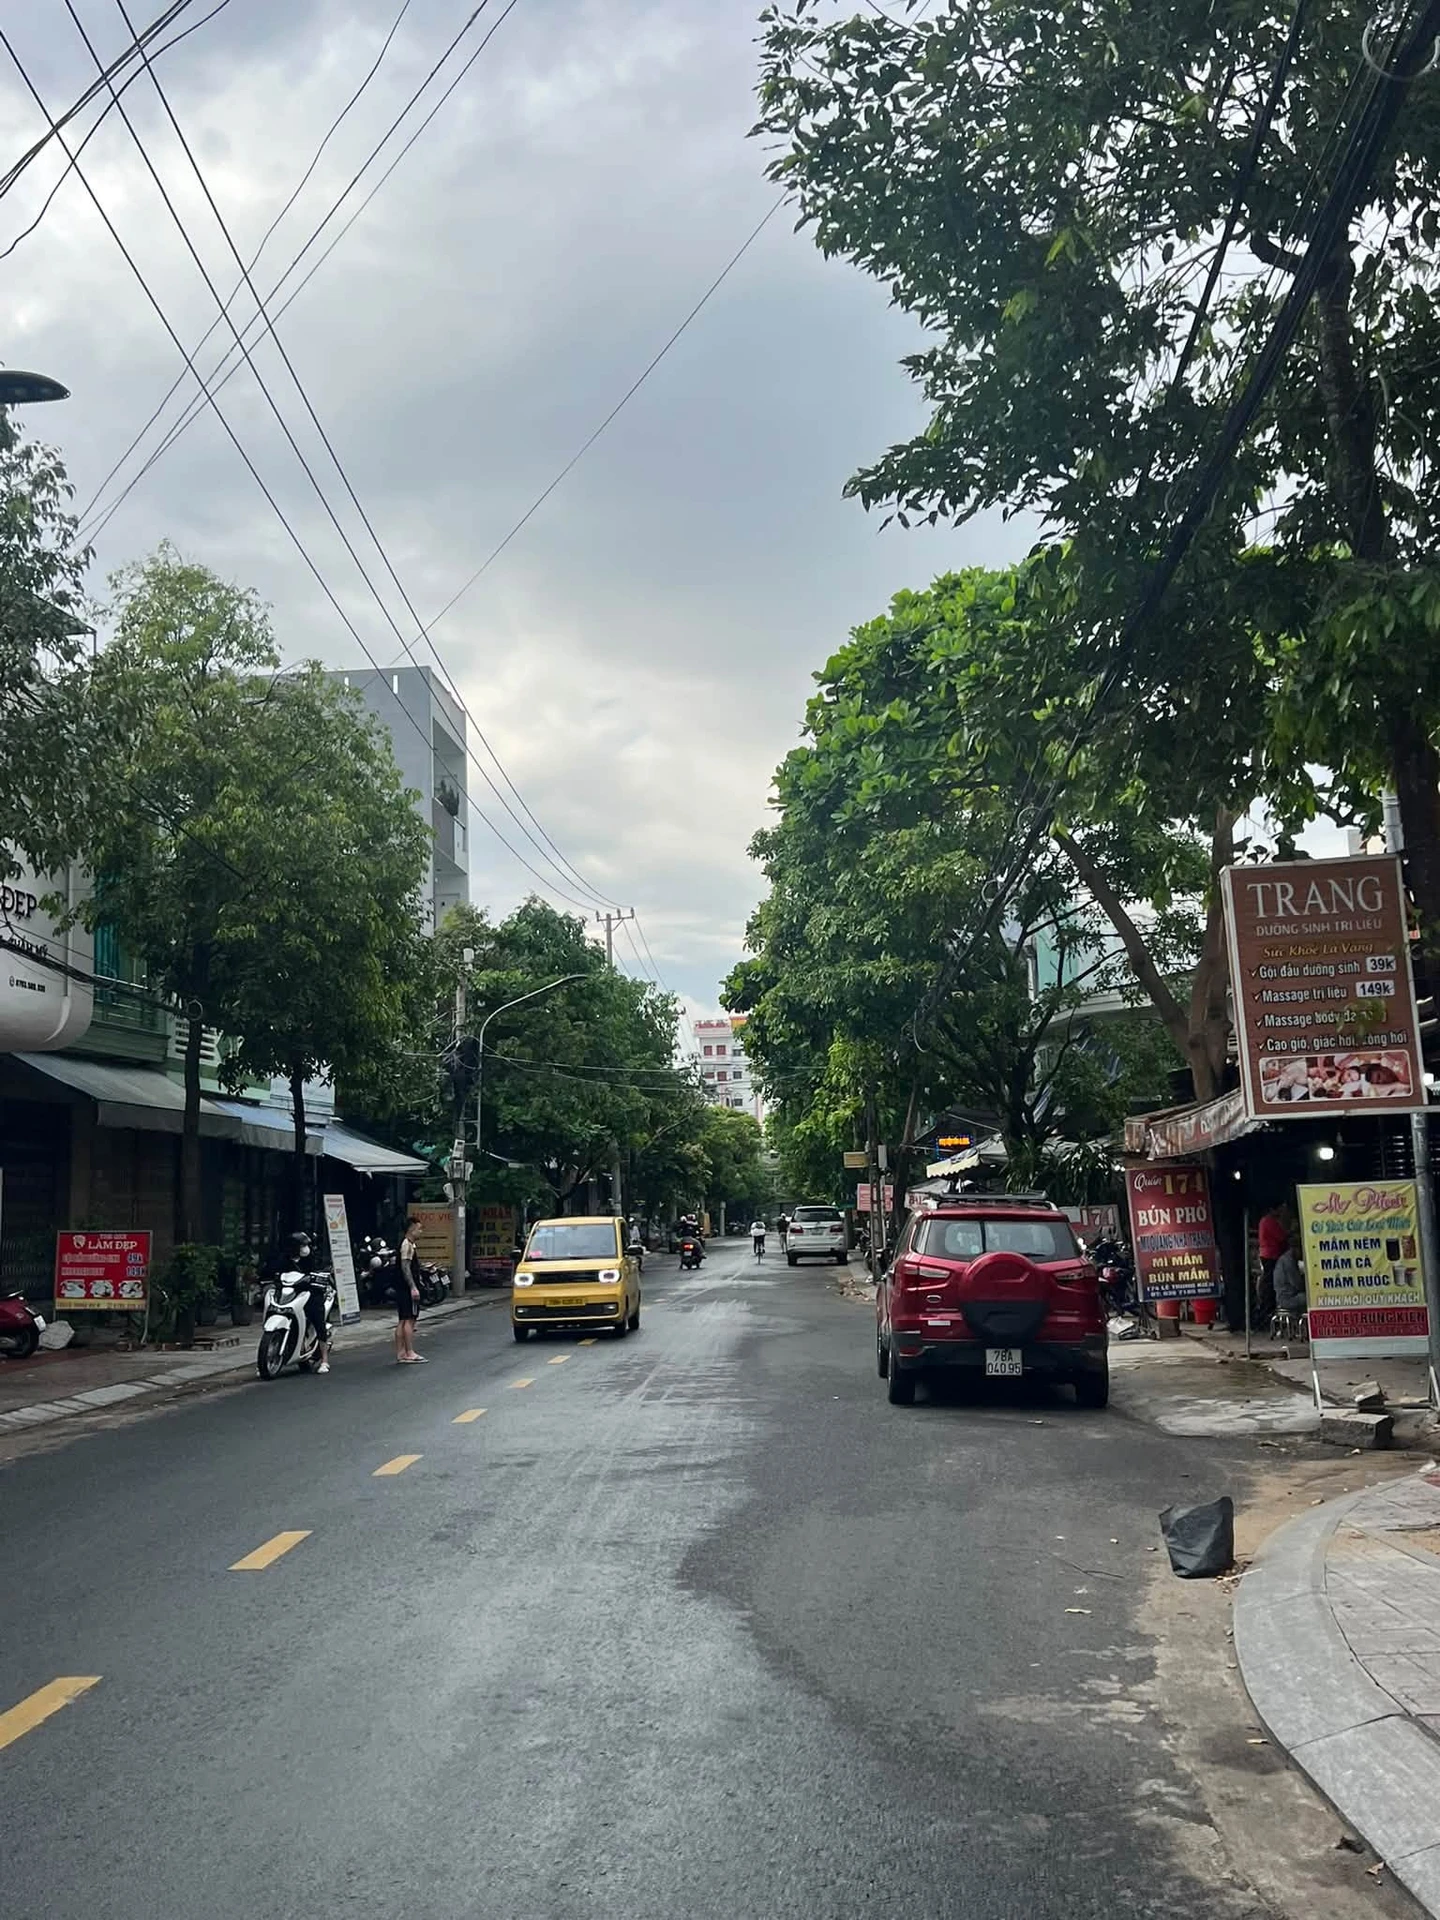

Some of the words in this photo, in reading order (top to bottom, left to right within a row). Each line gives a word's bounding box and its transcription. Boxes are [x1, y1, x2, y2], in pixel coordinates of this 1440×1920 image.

[1247, 876, 1383, 918] TRANG
[1302, 921, 1330, 934] SINH
[1259, 966, 1277, 981] Gội
[1338, 961, 1360, 974] sinh
[1370, 958, 1394, 971] 39k
[1262, 988, 1310, 1003] Massage
[1360, 982, 1394, 996] 149k
[1264, 1013, 1312, 1028] Massage
[1266, 1038, 1287, 1051] Cao
[1164, 1172, 1205, 1195] 174
[1138, 1204, 1170, 1227] BÚN
[1175, 1199, 1207, 1224] PHỞ
[1354, 1236, 1381, 1250] NÊM
[1354, 1311, 1396, 1324] TRUNG
[994, 1350, 1013, 1362] 78A
